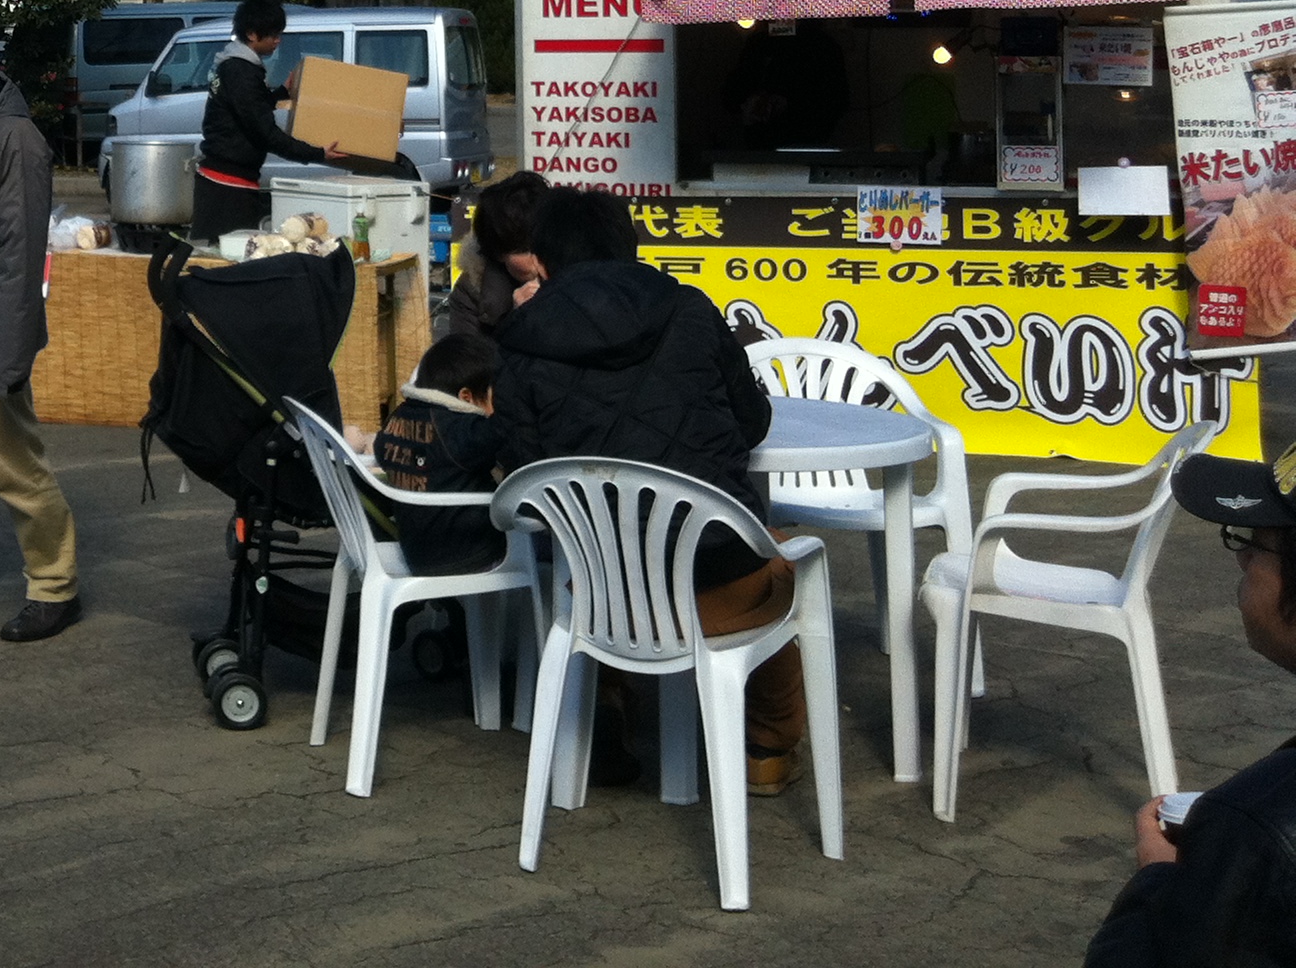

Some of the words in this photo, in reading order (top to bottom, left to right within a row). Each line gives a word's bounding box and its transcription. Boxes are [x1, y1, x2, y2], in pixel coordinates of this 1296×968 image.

[531, 81, 658, 98] TAKOYAKI
[531, 106, 658, 123] YAKISOBA
[531, 131, 631, 148] TAIYAKI
[532, 156, 618, 173] DANGO
[872, 215, 922, 240] 300
[724, 257, 808, 283] 600
[826, 257, 1188, 291] 年の伝統食材
